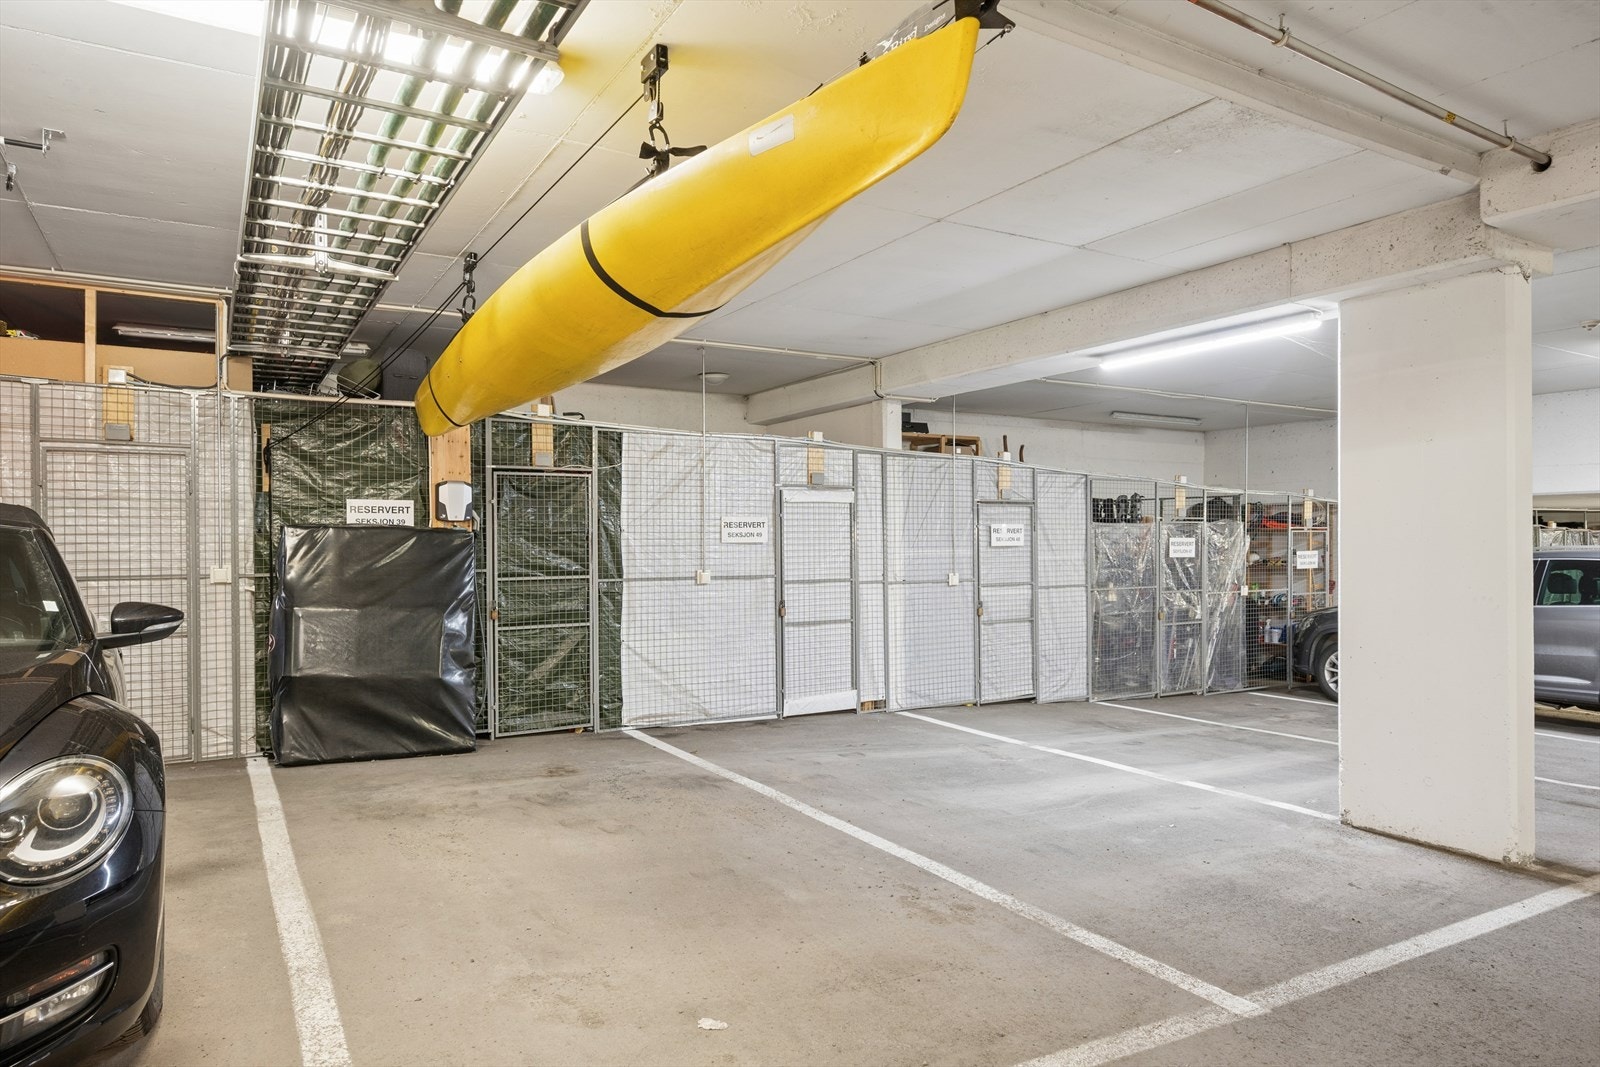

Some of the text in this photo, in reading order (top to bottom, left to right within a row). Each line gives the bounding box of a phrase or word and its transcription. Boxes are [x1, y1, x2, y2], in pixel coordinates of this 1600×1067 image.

[924, 12, 947, 33] Designs
[349, 505, 411, 514] RESERVERT
[723, 521, 766, 529] RESERVERT
